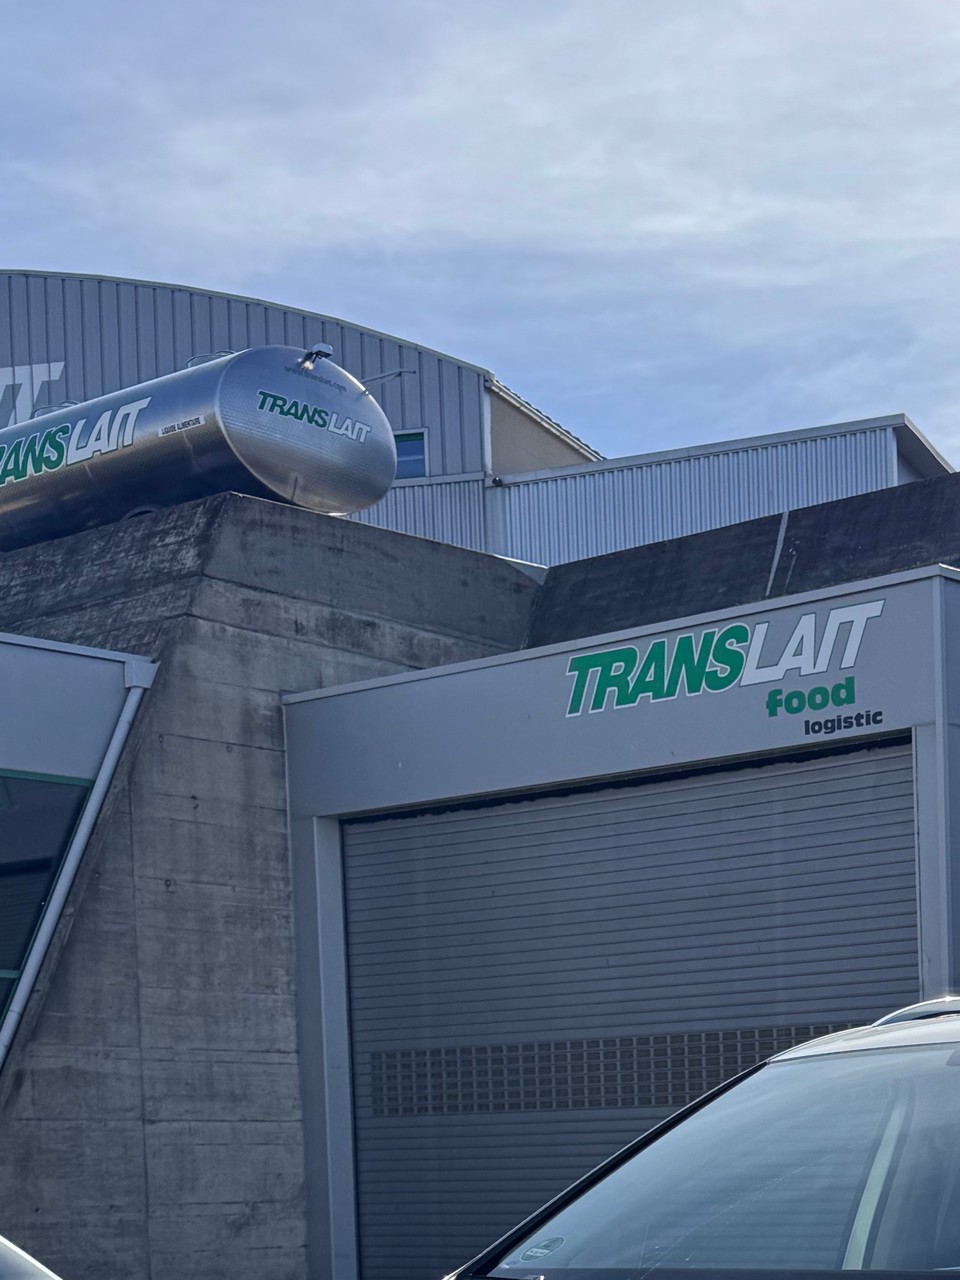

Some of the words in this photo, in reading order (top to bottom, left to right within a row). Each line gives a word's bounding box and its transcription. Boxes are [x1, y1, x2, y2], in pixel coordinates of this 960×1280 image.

[257, 389, 372, 444] TRANSLAIT
[565, 598, 886, 718] TRANSLAIT
[765, 676, 856, 718] food
[804, 710, 884, 736] logistic
